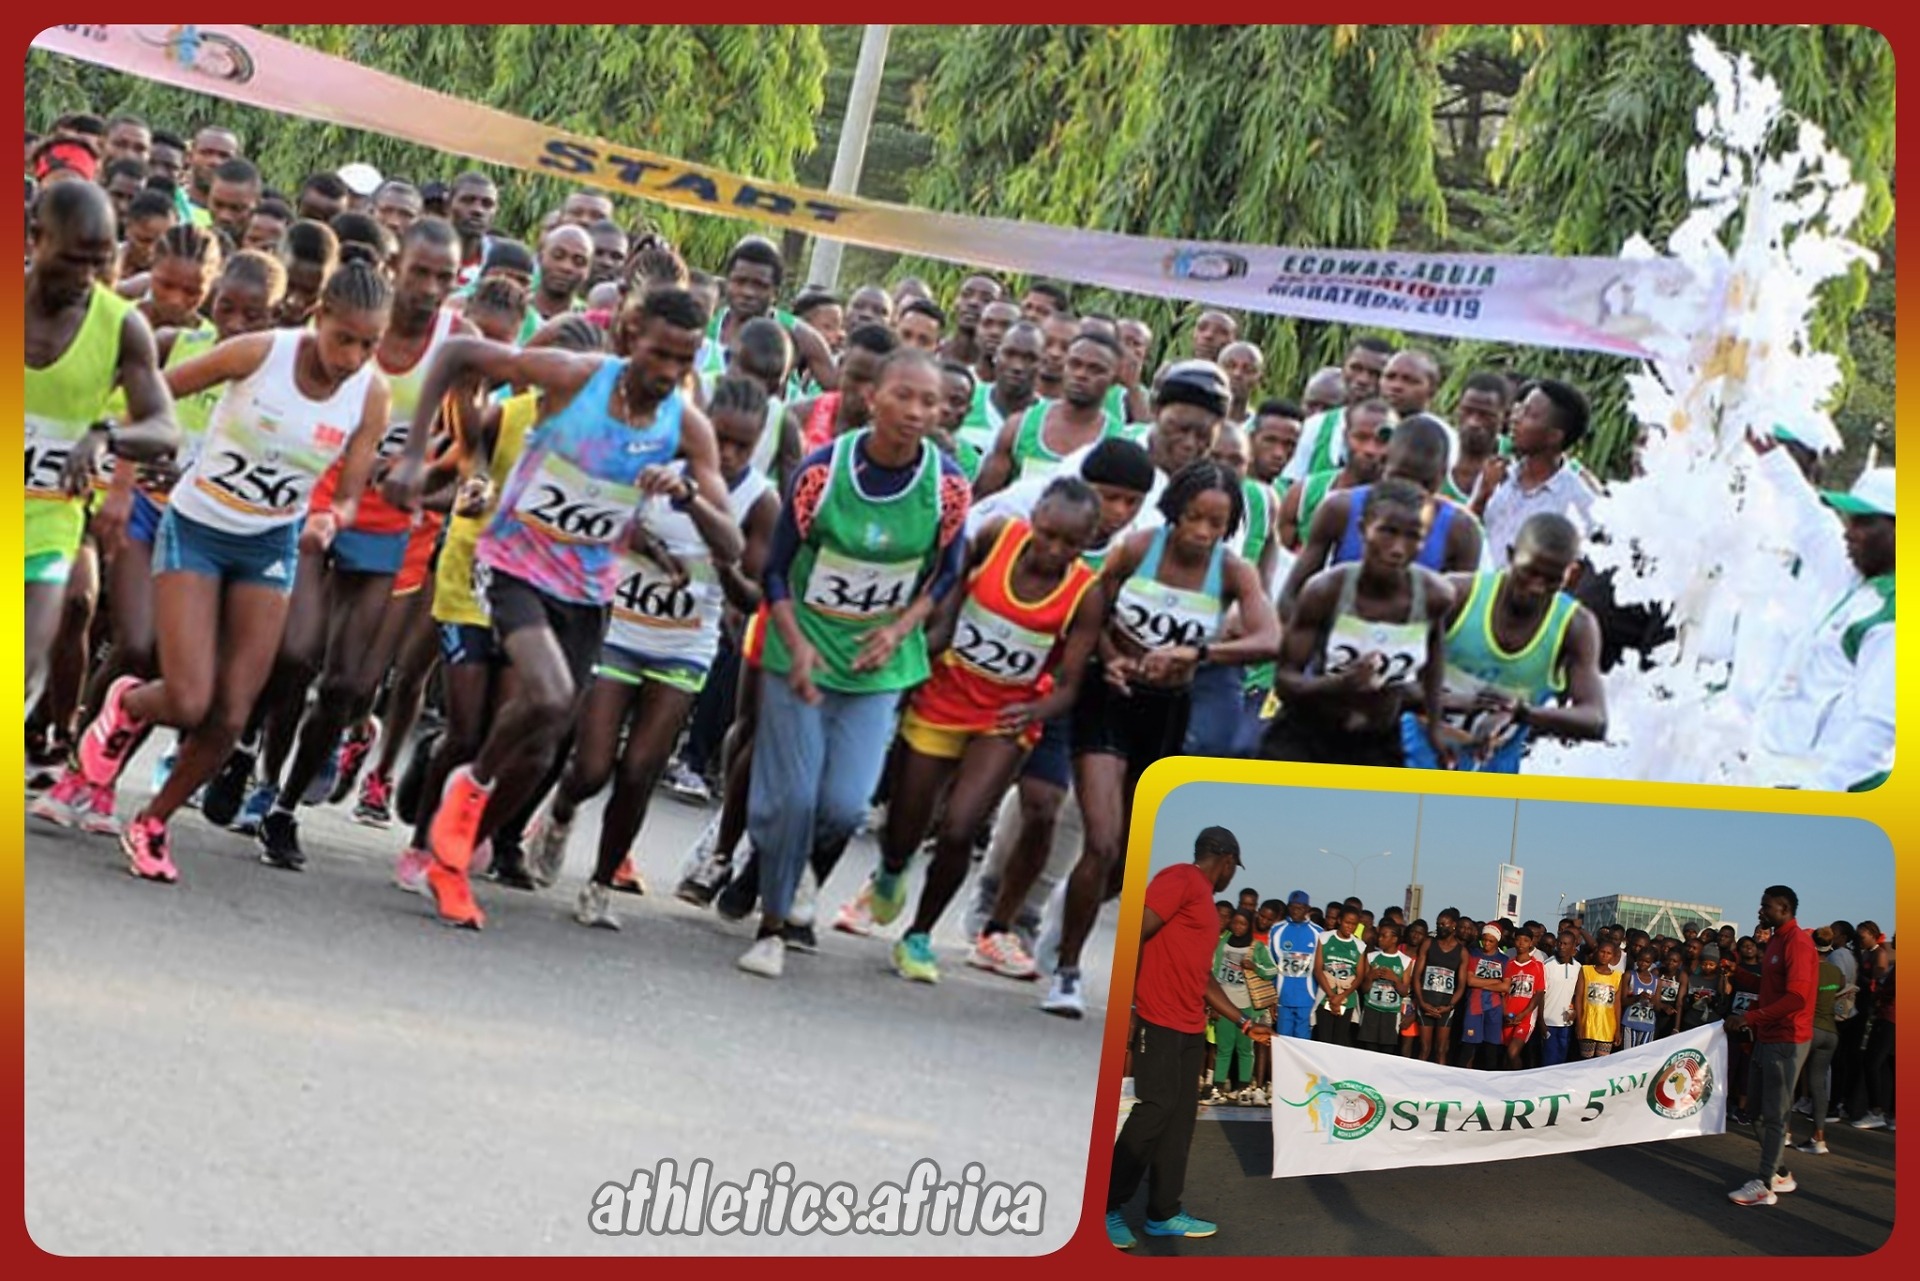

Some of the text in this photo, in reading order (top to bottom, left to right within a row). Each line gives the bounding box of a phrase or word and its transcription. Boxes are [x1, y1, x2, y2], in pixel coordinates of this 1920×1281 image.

[537, 139, 857, 224] START
[1282, 255, 1496, 287] ECOWAS-ABUJA
[1416, 297, 1481, 319] 2019
[209, 449, 304, 508] 256
[527, 484, 622, 539] 266
[616, 571, 695, 617] 460
[815, 574, 903, 612] 344
[955, 622, 1036, 676] 229
[1221, 967, 1245, 985] 162
[1631, 1005, 1655, 1020] 230
[1389, 1093, 1572, 1132] START
